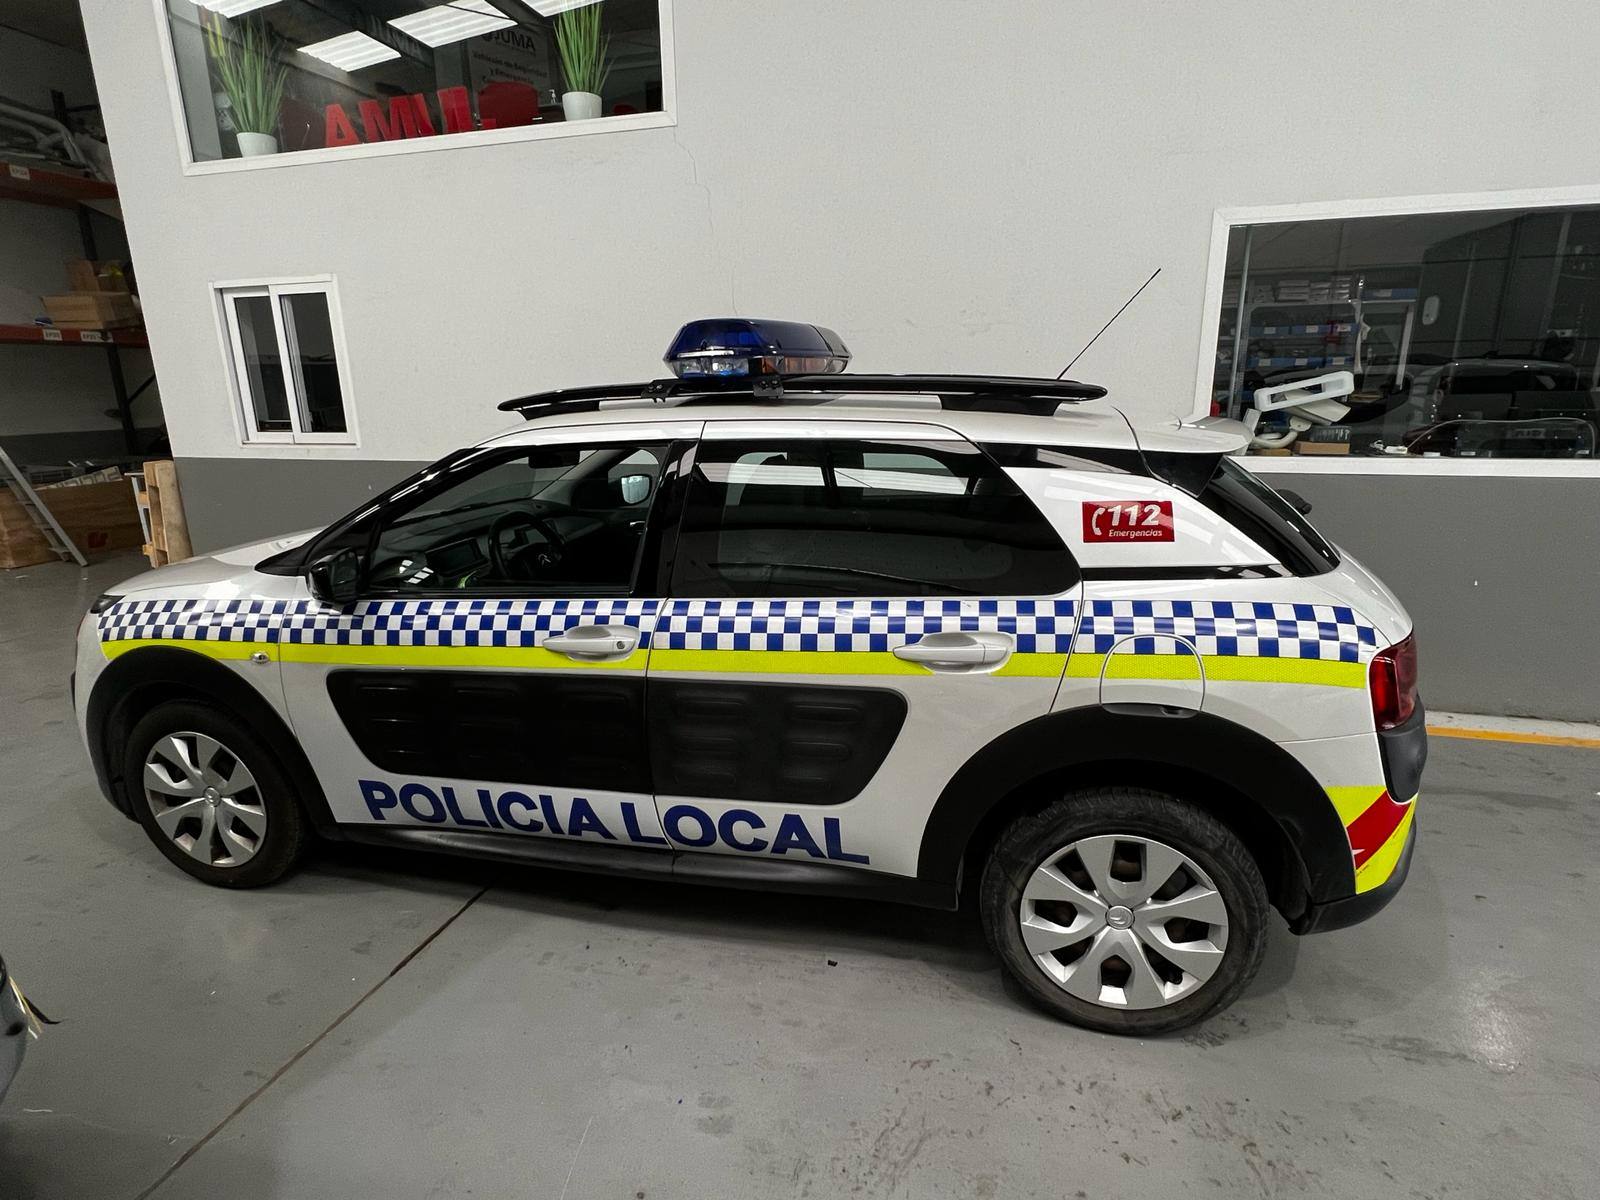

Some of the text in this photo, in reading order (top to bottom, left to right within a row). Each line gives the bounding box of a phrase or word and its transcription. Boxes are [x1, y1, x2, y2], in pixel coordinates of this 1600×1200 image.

[1107, 504, 1161, 526] 112
[1108, 529, 1162, 539] Emergencias
[358, 779, 871, 865] POLICIA LOCAL
